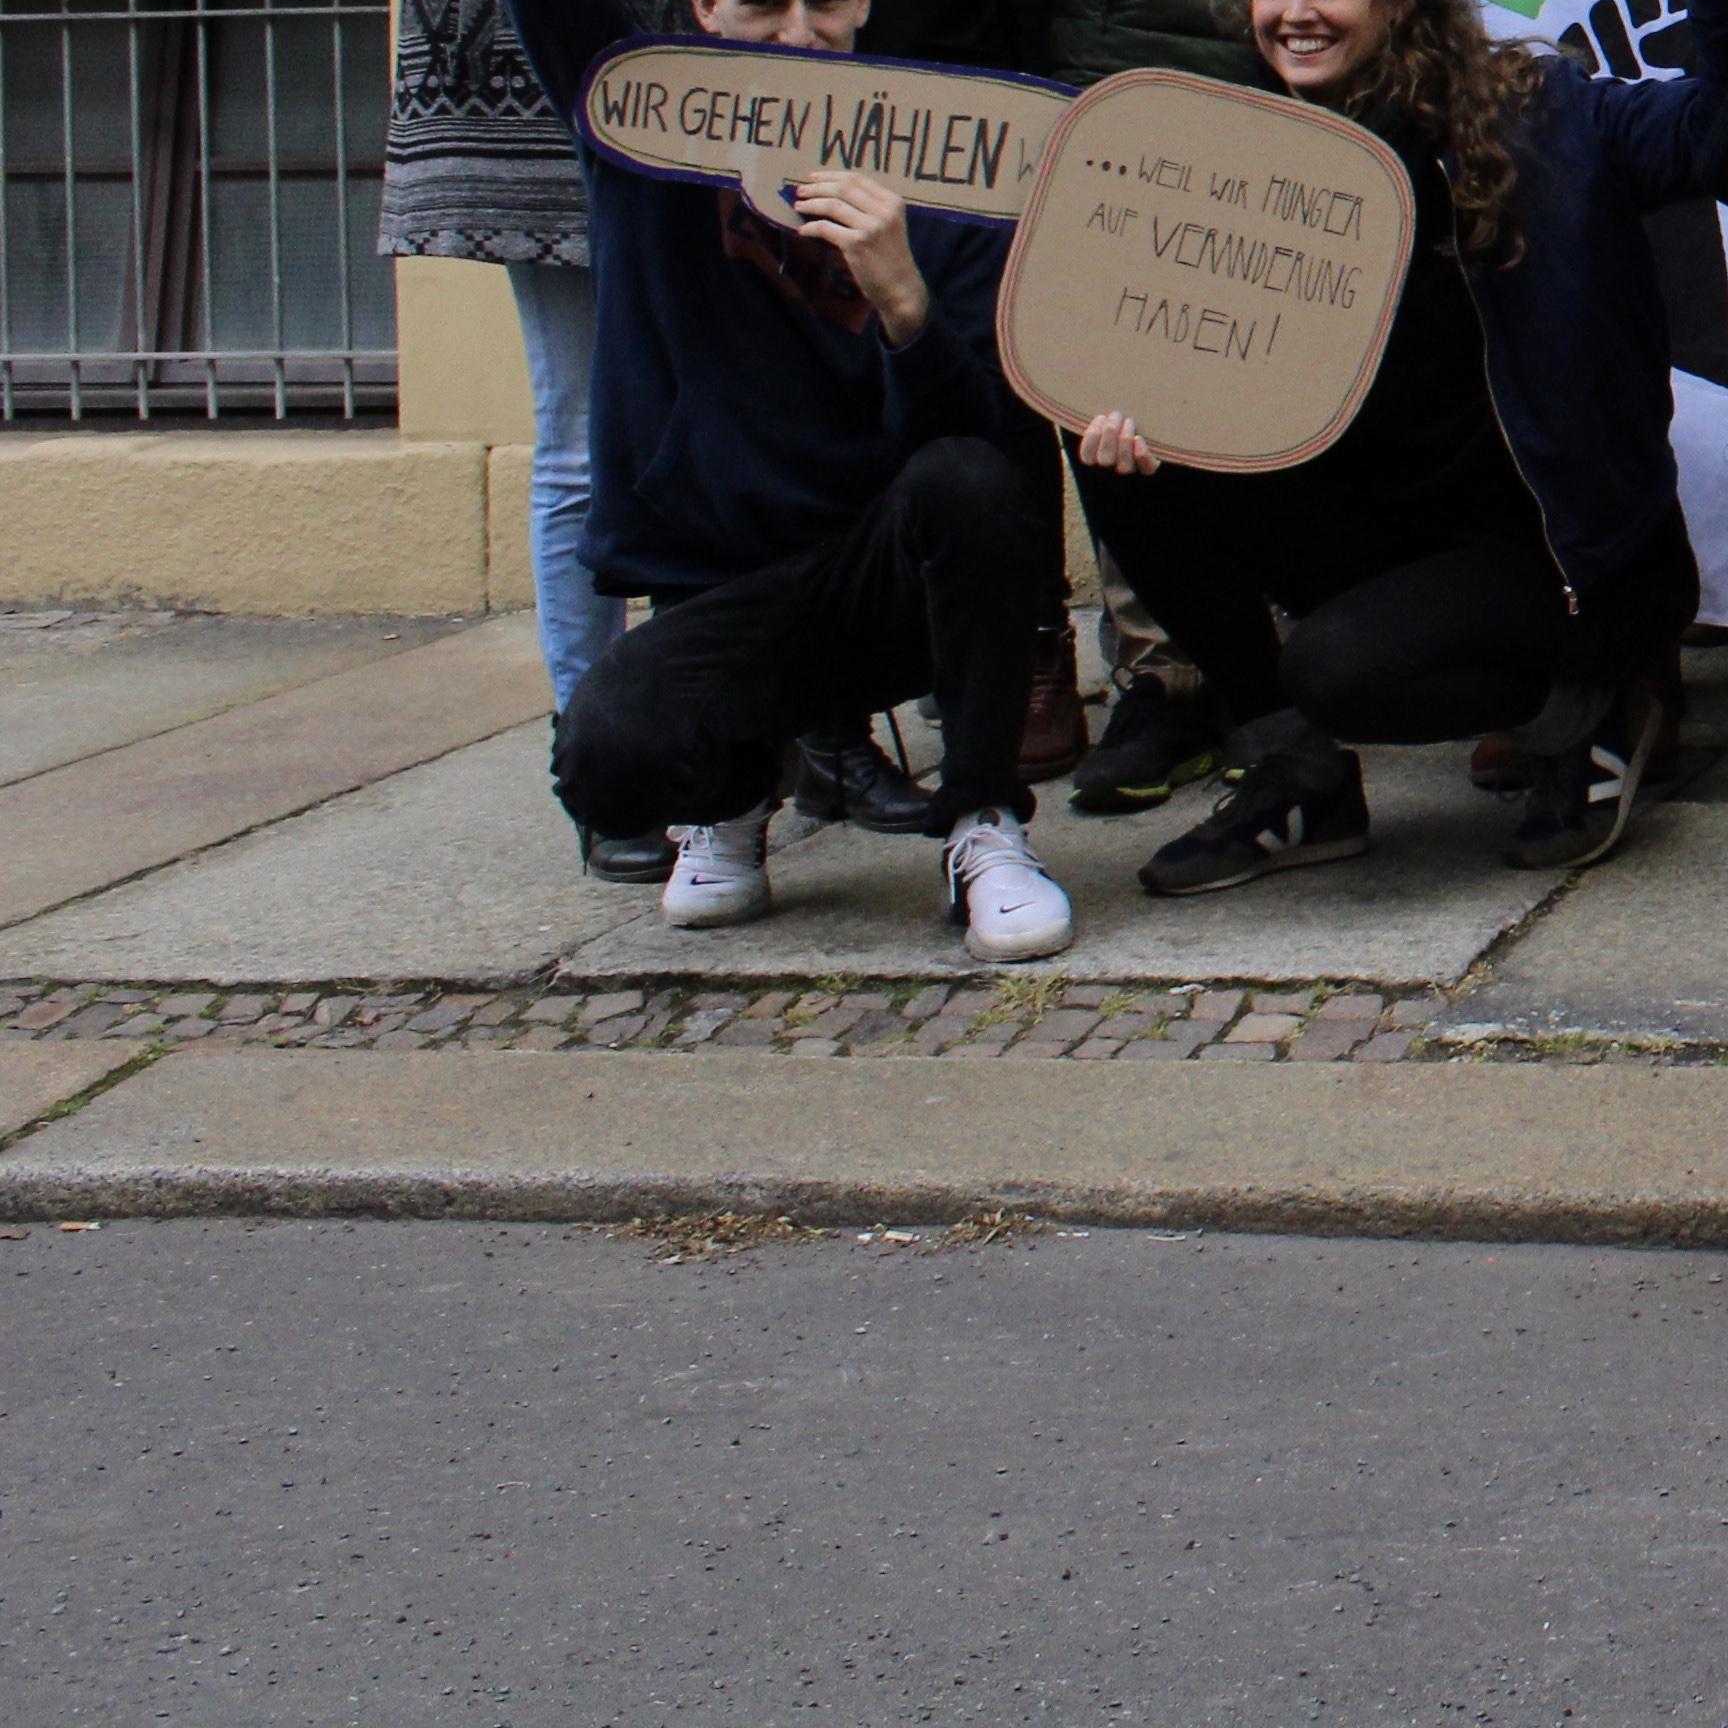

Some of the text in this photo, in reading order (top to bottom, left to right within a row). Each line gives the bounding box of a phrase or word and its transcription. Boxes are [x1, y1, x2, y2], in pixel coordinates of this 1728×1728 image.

[601, 80, 668, 133] WIR
[679, 86, 811, 150] GEHEN
[818, 90, 1009, 190] WÄHLEN
[1085, 201, 1140, 239] AUF
[1261, 173, 1365, 242] HUNGER
